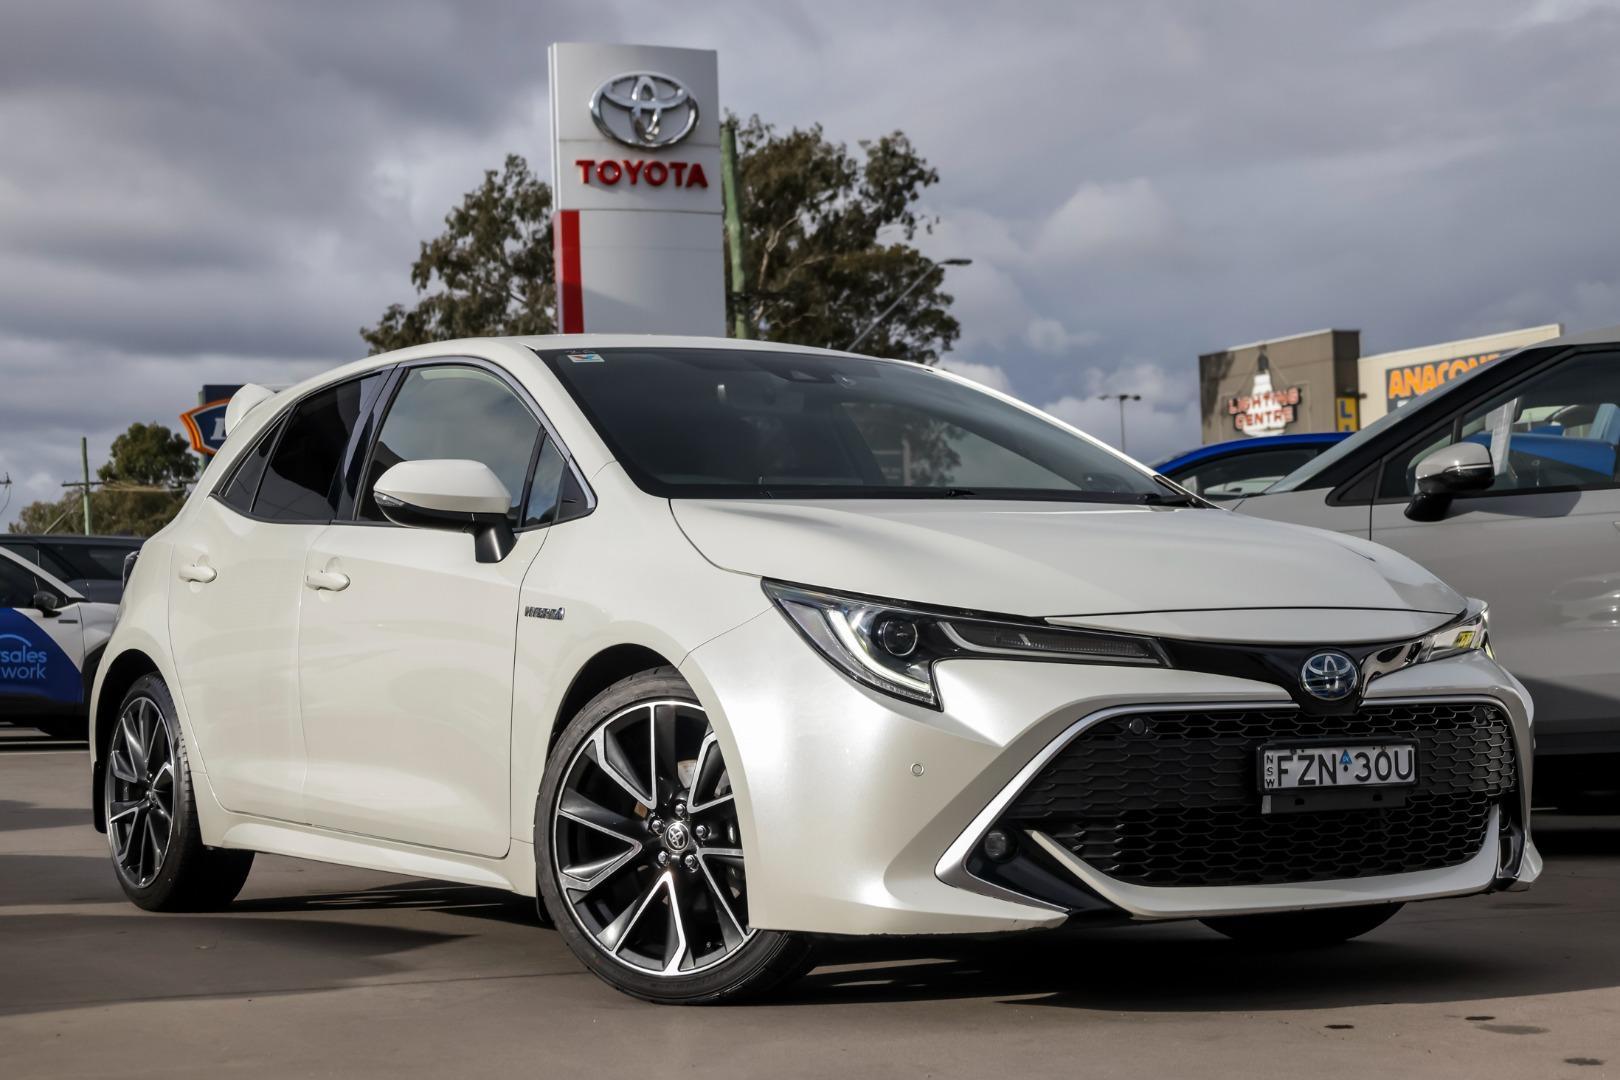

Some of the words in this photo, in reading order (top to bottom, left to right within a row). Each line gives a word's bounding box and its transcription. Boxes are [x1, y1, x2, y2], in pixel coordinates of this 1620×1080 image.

[575, 159, 709, 189] TOYOTA
[1388, 352, 1501, 400] ANACO
[1228, 387, 1300, 415] LIGHTING
[1234, 406, 1295, 430] CENTRE
[0, 644, 48, 664] sales
[1, 662, 47, 680] work
